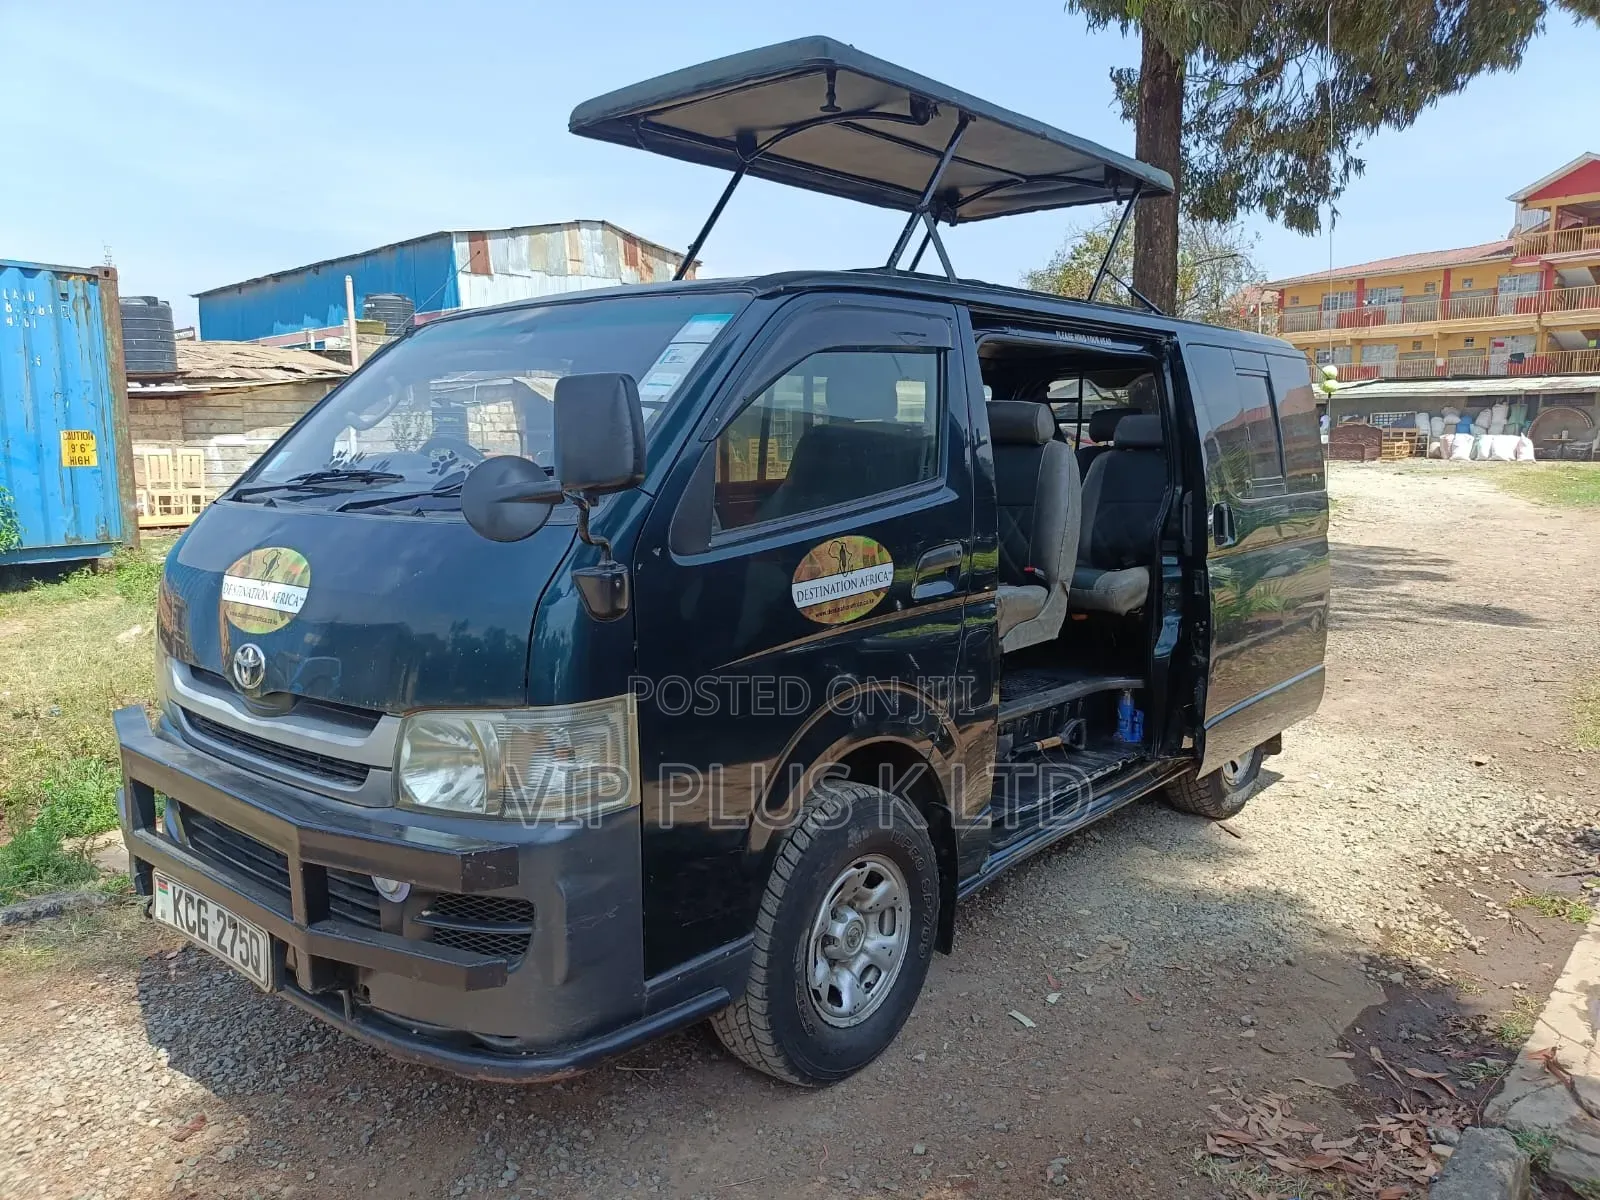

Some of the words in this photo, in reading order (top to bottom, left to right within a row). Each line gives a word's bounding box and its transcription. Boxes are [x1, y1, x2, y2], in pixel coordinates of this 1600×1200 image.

[62, 431, 94, 441] CAUTION
[69, 455, 91, 466] HIGH
[222, 582, 271, 601] DESTINATION
[271, 590, 299, 607] AFRICA
[796, 577, 858, 602] DESTINATION
[859, 570, 889, 588] AFRICA
[172, 885, 209, 943] KCG
[216, 908, 262, 980] 275Q
